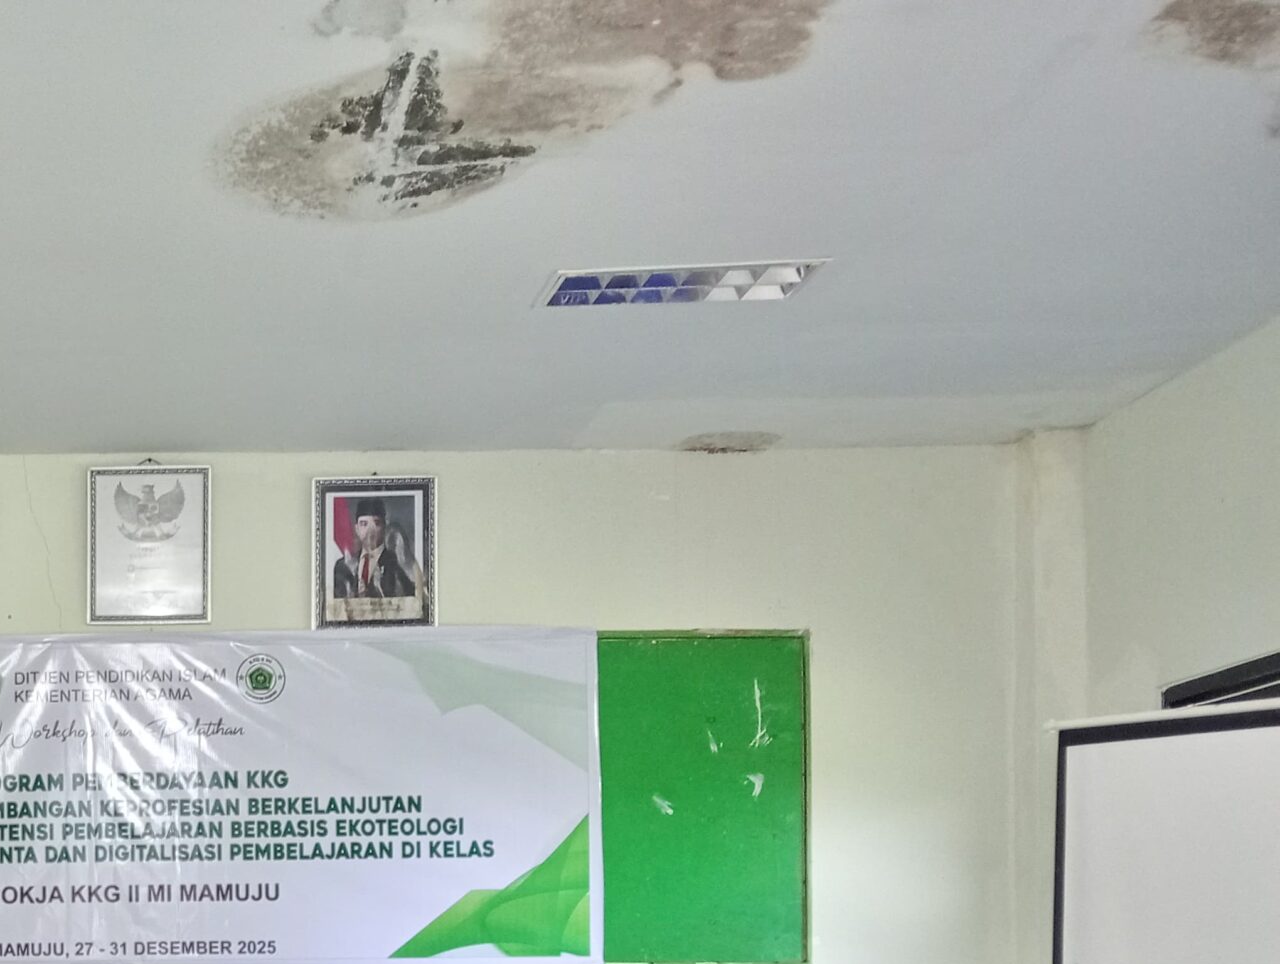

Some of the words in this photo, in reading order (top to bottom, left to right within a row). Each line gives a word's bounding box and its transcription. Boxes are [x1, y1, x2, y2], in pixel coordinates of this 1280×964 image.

[14, 671, 69, 685] DITJEN
[75, 669, 172, 684] PENDIDIKAN
[178, 668, 227, 682] ISLAM
[14, 688, 130, 703] KEMENTERIAN
[132, 687, 192, 701] AGAMA
[246, 770, 289, 789] KKG
[100, 798, 240, 818] KEPROFESIAN
[248, 796, 422, 815] BERKELANJUTAN
[62, 820, 223, 840] PEMBELAJARAN
[231, 819, 327, 838] BERBASIS
[335, 817, 464, 836] EKOTEOLOGI
[45, 845, 86, 863] DAN
[95, 843, 222, 863] DIGITALISASI
[230, 841, 393, 861] PEMBELAJARAN
[401, 841, 421, 859] DI
[429, 840, 494, 858] KELAS
[71, 885, 120, 903] KKG
[128, 885, 139, 902] II
[148, 884, 172, 902] MI
[180, 883, 280, 902] MAMUJU
[75, 943, 93, 957] 27
[109, 942, 126, 956] 31
[134, 941, 232, 955] DESEMBER
[238, 940, 277, 954] 2025
